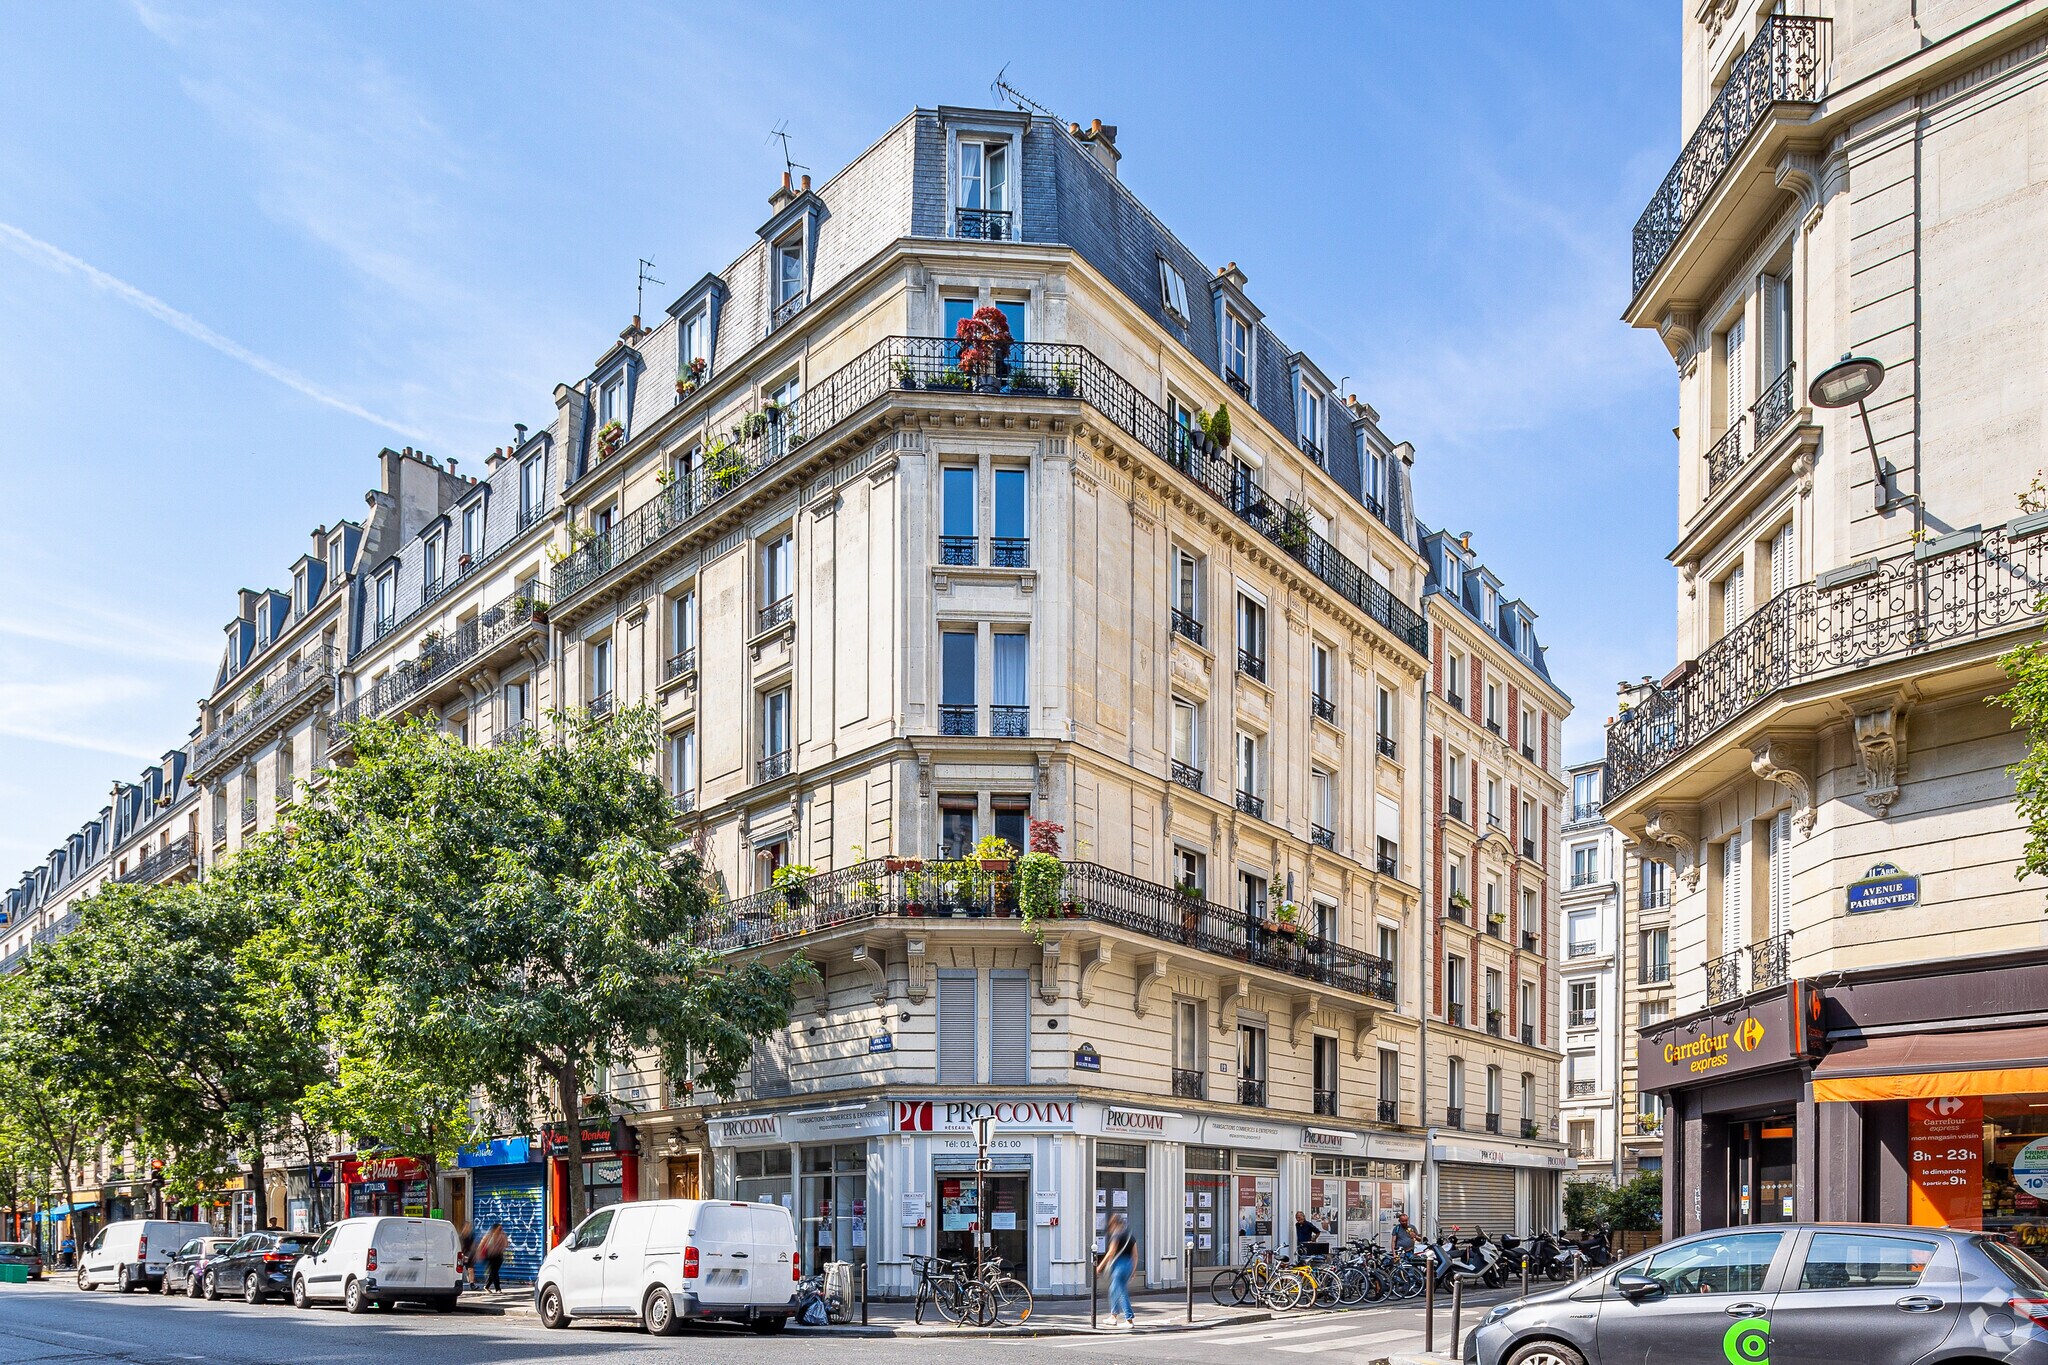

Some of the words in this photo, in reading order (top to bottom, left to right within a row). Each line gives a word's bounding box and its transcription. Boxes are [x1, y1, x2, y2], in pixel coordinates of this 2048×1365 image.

[1862, 883, 1902, 897] AVENUE
[1850, 892, 1916, 909] PARMENTIER
[1663, 1031, 1729, 1063] Carrefour
[1690, 1053, 1728, 1073] express
[945, 1102, 1074, 1123] PROCOMM
[1106, 1110, 1164, 1130] PROCOMM
[723, 1117, 776, 1136] PROCOMM
[1923, 1117, 1966, 1126] Carrefour
[581, 1129, 610, 1142] Donkey
[1928, 1134, 1957, 1142] magasin
[960, 1140, 970, 1148] 01
[998, 1140, 1008, 1148] 61
[1010, 1140, 1021, 1148] 00
[1913, 1150, 1932, 1161] 8h
[1947, 1149, 1977, 1160] 23h
[372, 1160, 399, 1181] Palette
[1949, 1176, 1967, 1185] 9h
